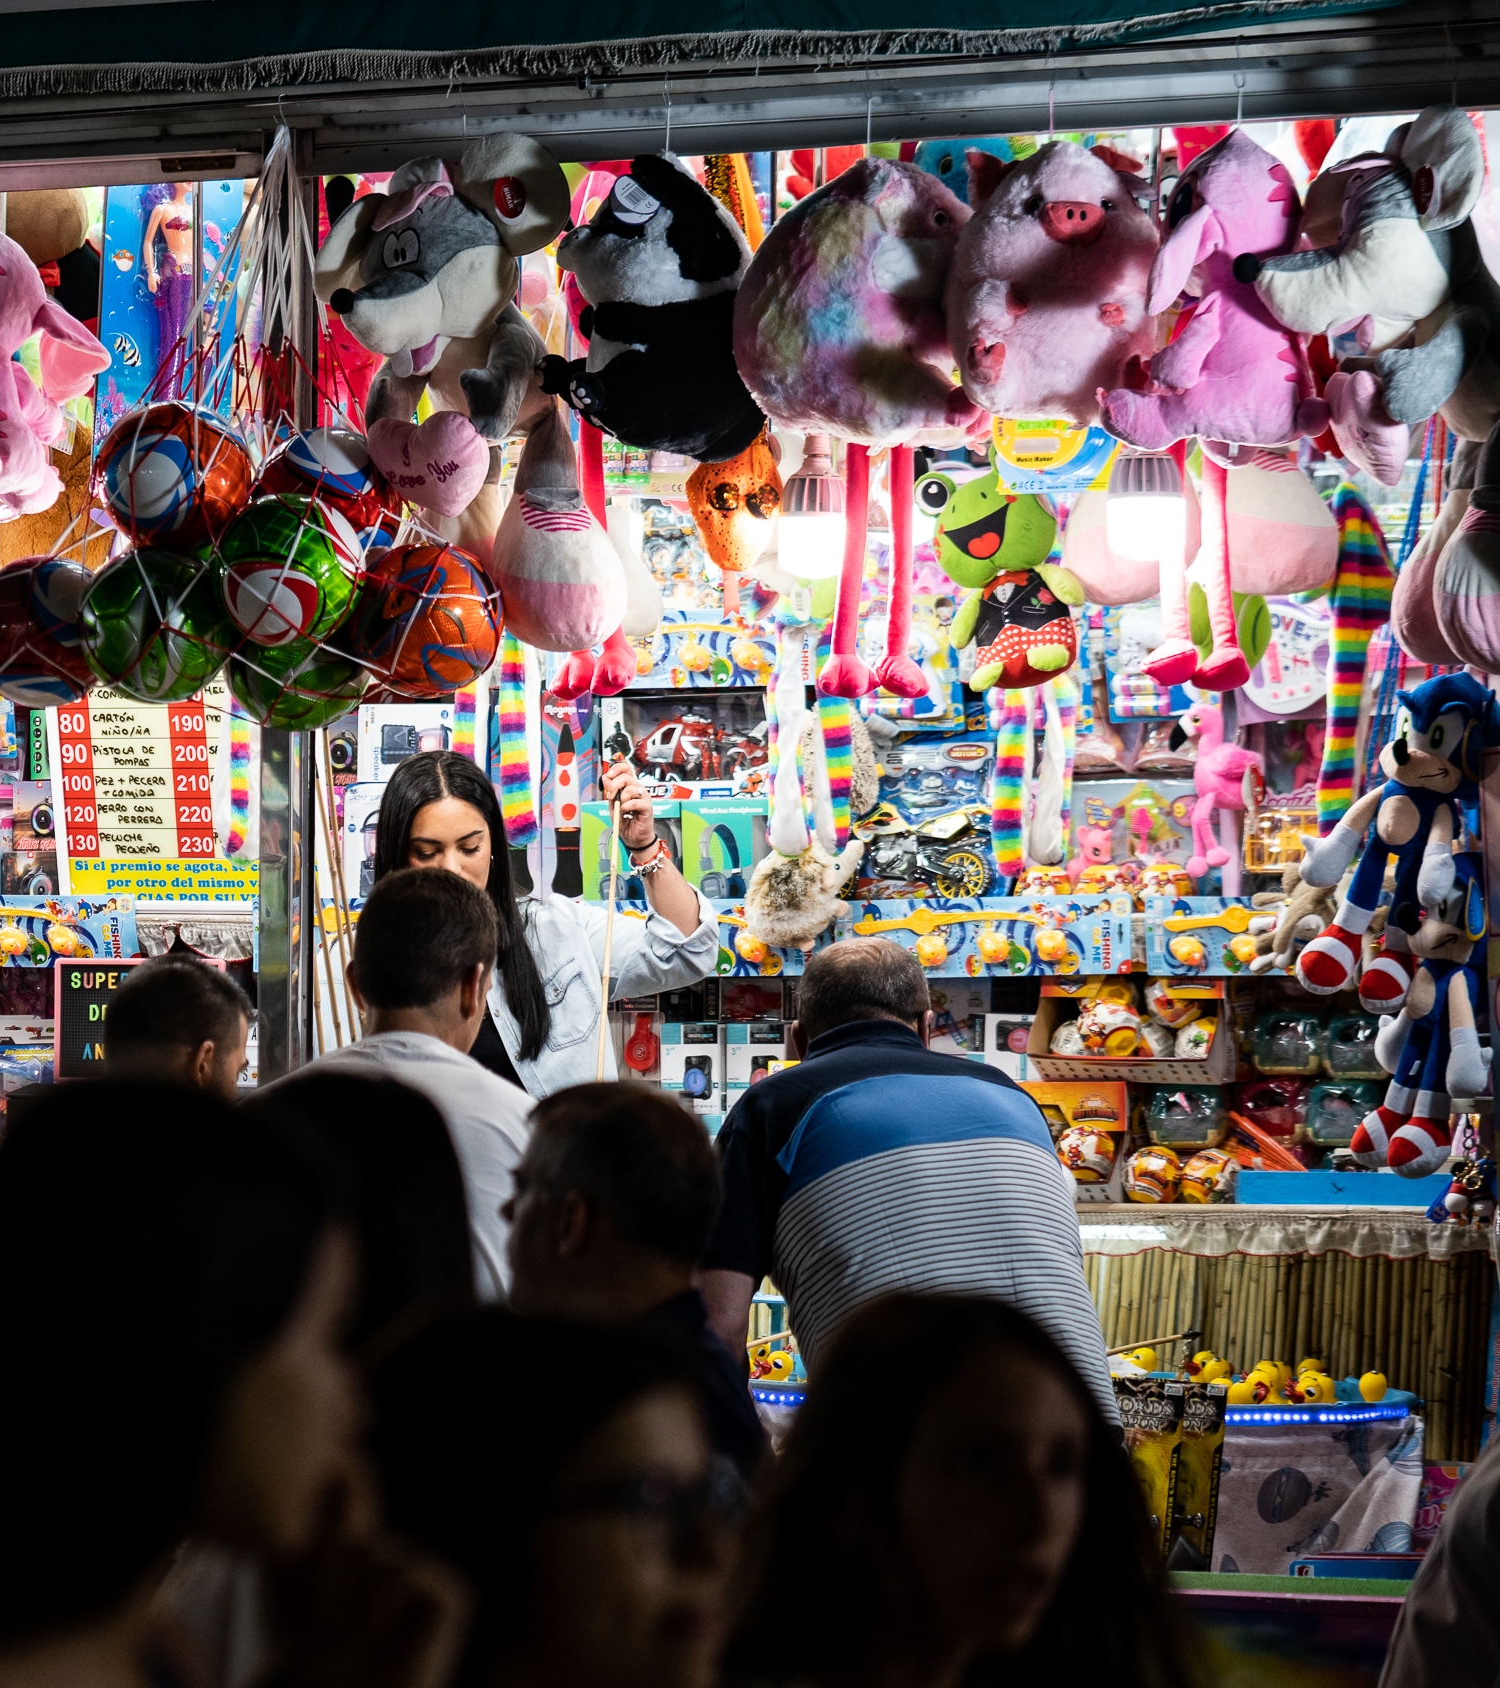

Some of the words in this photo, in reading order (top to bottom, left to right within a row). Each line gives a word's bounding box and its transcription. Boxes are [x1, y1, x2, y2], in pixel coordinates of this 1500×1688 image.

[503, 187, 514, 209] BIMAR
[427, 460, 459, 483] You
[1270, 614, 1306, 637] OVE
[92, 712, 135, 723] CARTÓN
[544, 704, 577, 719] Magma
[60, 713, 86, 734] 80
[171, 714, 204, 732] 190
[62, 744, 88, 764] 90
[142, 746, 155, 755] DE
[174, 745, 208, 763] 200
[113, 757, 150, 767] POMPAS
[63, 776, 92, 792] 100
[95, 776, 115, 786] PEZ
[129, 776, 166, 786] PECERA
[176, 774, 210, 792] 210
[64, 806, 95, 823] 120
[98, 804, 128, 814] PERRO
[134, 805, 154, 813] CON
[179, 806, 212, 823] 220
[118, 816, 163, 825] PERRERA
[67, 834, 97, 851] 130
[115, 842, 161, 855] PEQUEÑO
[180, 836, 213, 853] 230
[74, 860, 89, 871] Si
[94, 861, 106, 871] el
[110, 861, 162, 874] premio
[166, 863, 180, 871] se
[184, 862, 228, 874] agota,
[106, 878, 132, 889] por
[136, 879, 167, 888] otro
[170, 878, 193, 888] del
[198, 878, 245, 888] mismo
[102, 924, 113, 958] GAME
[1092, 926, 1101, 965] GAME
[1102, 920, 1111, 971] FISHING
[1166, 1497, 1174, 1528] WEAPON
